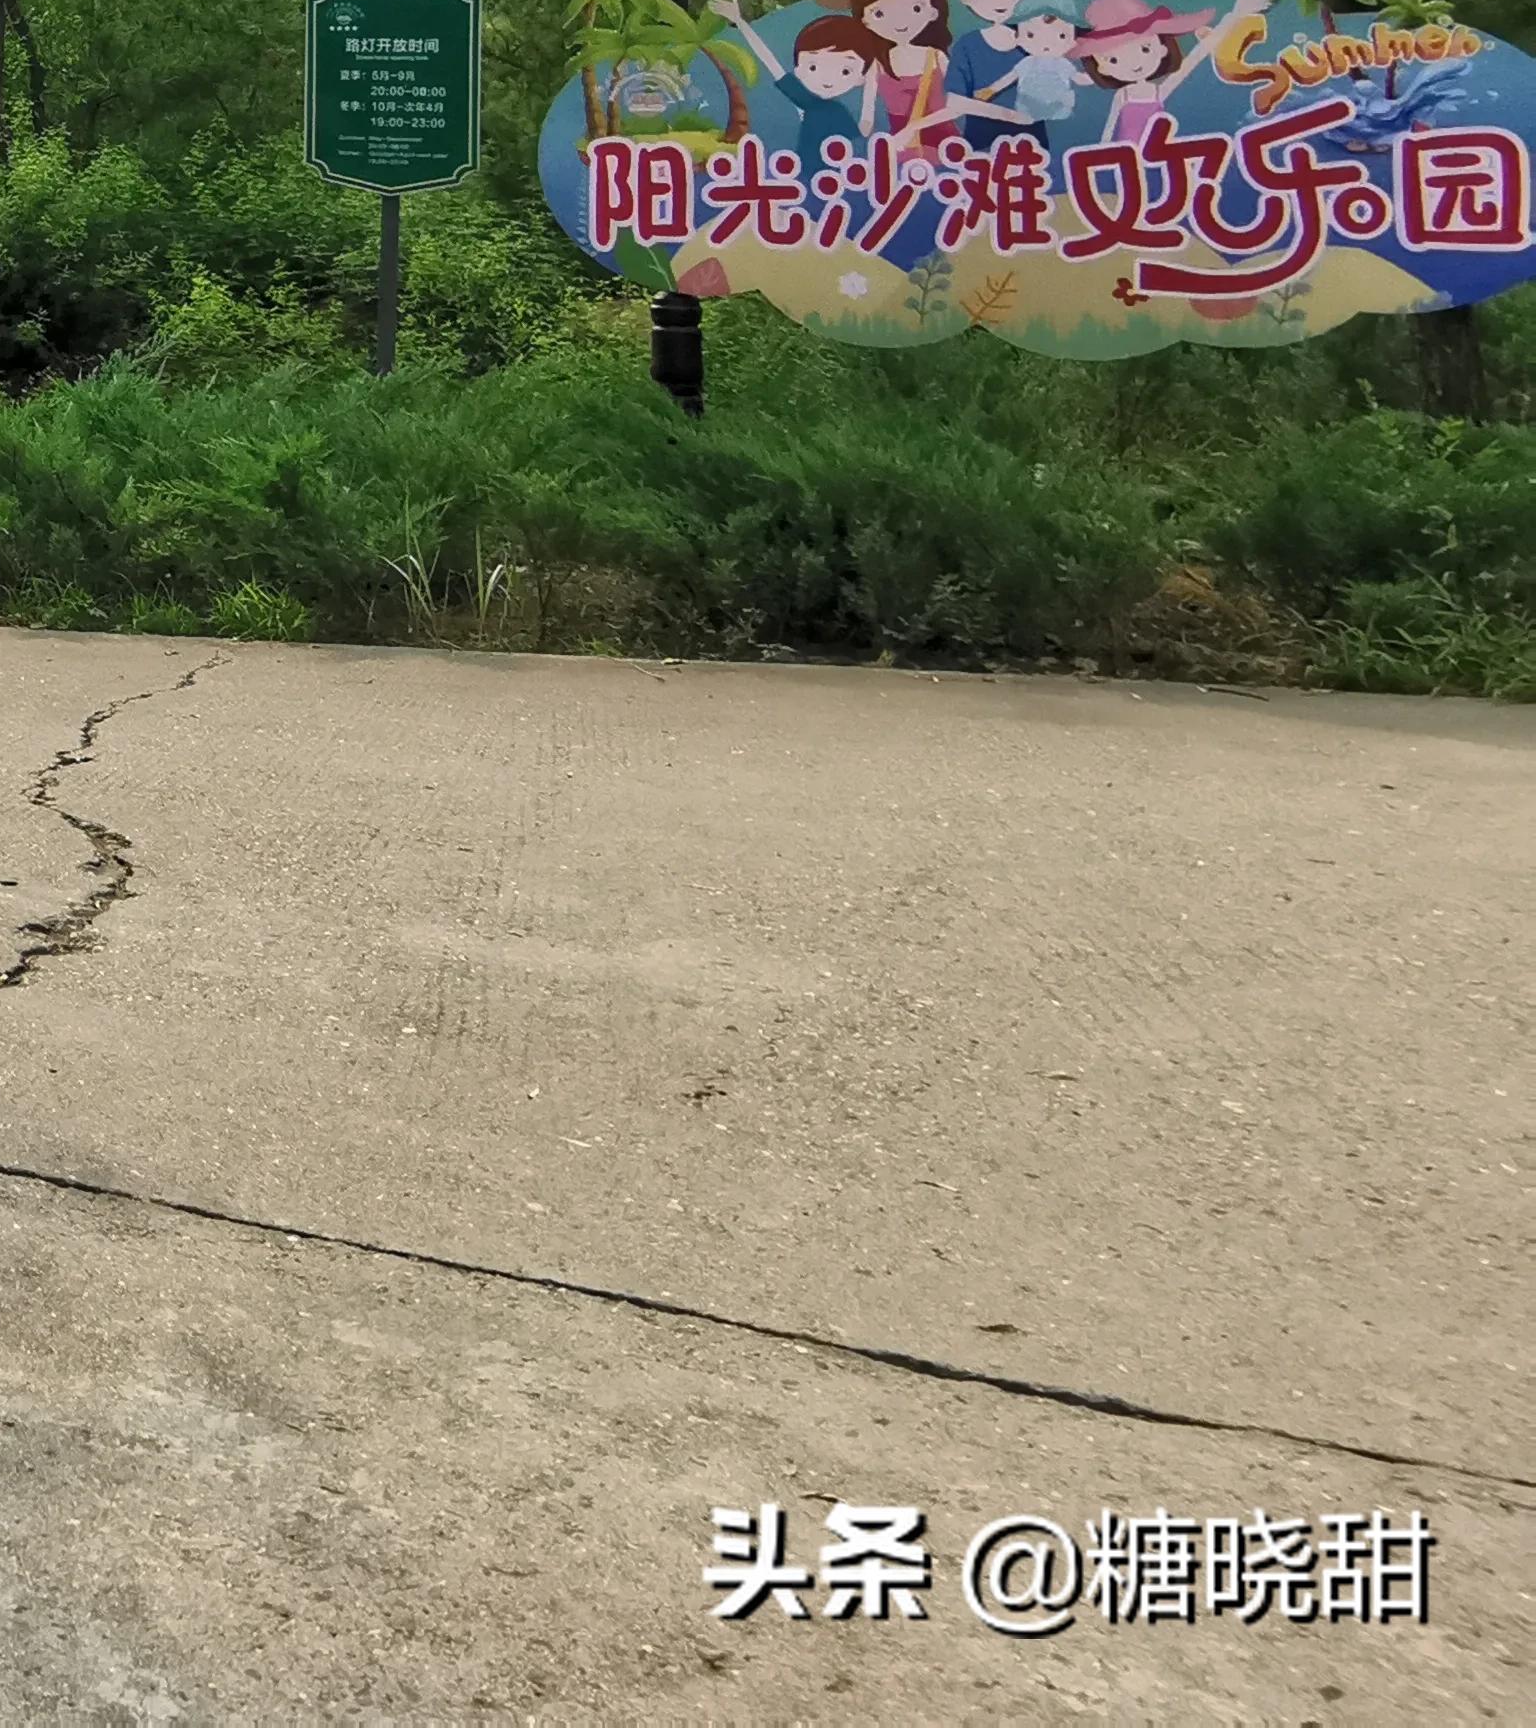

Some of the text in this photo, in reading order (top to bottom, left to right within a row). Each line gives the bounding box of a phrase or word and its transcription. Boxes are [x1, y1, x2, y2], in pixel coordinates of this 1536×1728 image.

[345, 38, 440, 53] 路灯开放时间
[585, 102, 1534, 299] 阳光沙滩欢乐园
